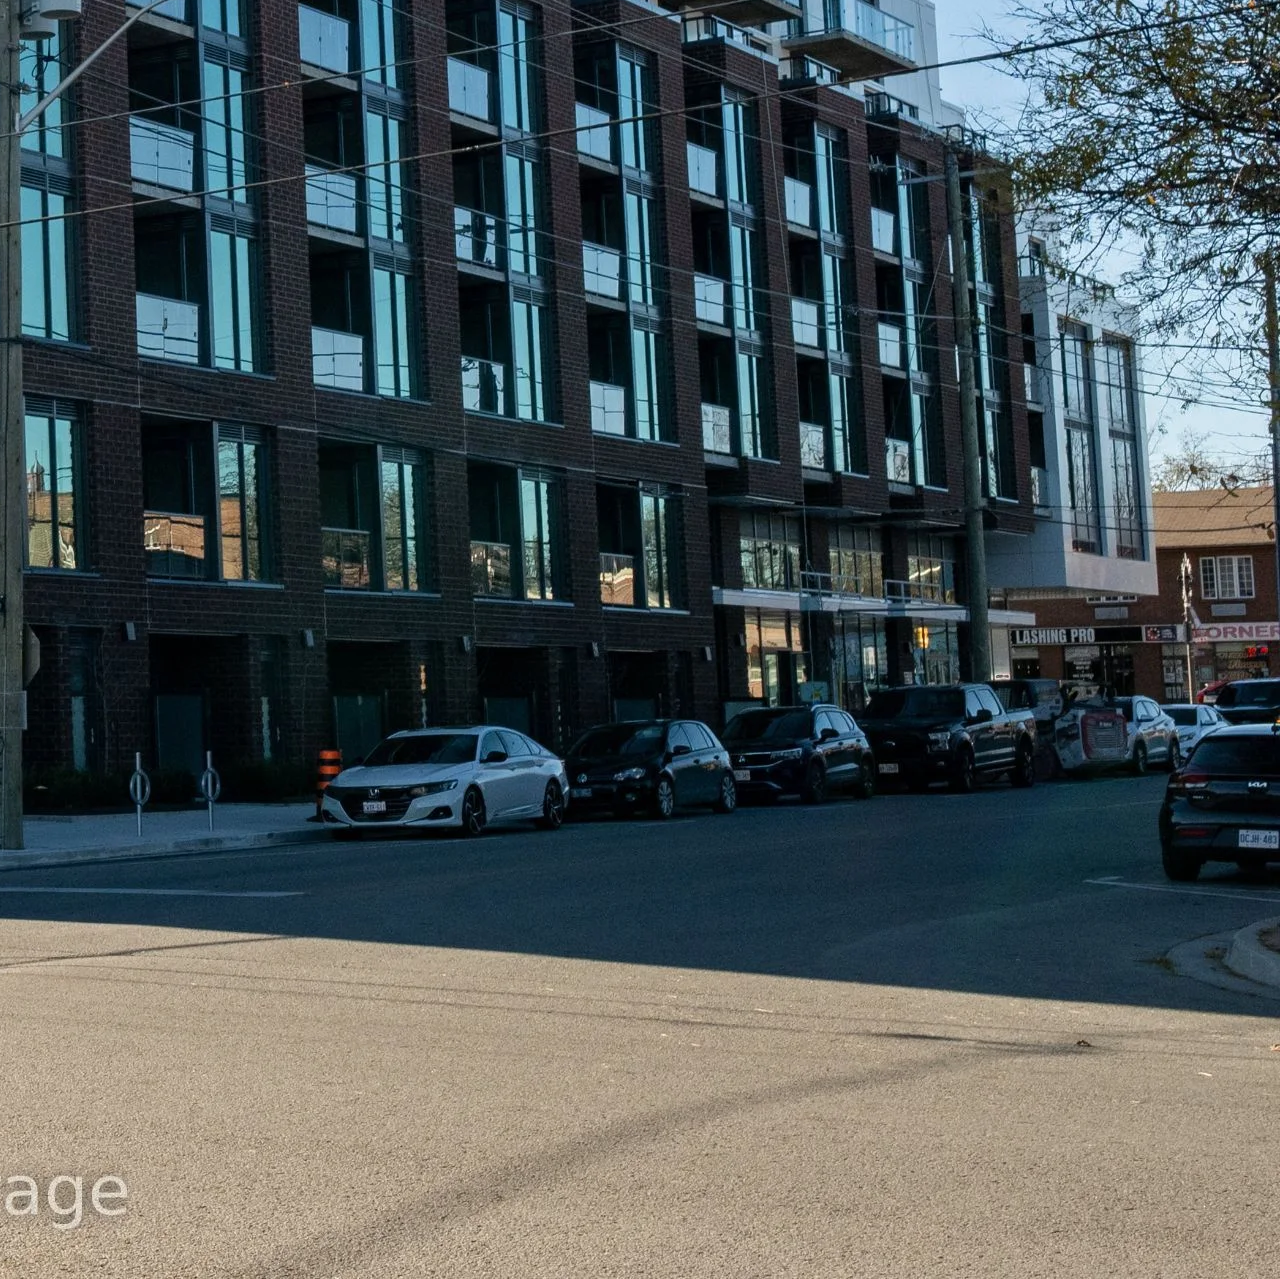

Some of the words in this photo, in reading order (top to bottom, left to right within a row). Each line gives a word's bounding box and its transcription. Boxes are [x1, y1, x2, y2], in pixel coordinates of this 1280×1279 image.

[1016, 629, 1067, 644] LASHING
[1071, 628, 1096, 643] PRO
[1192, 624, 1280, 639] ORNER
